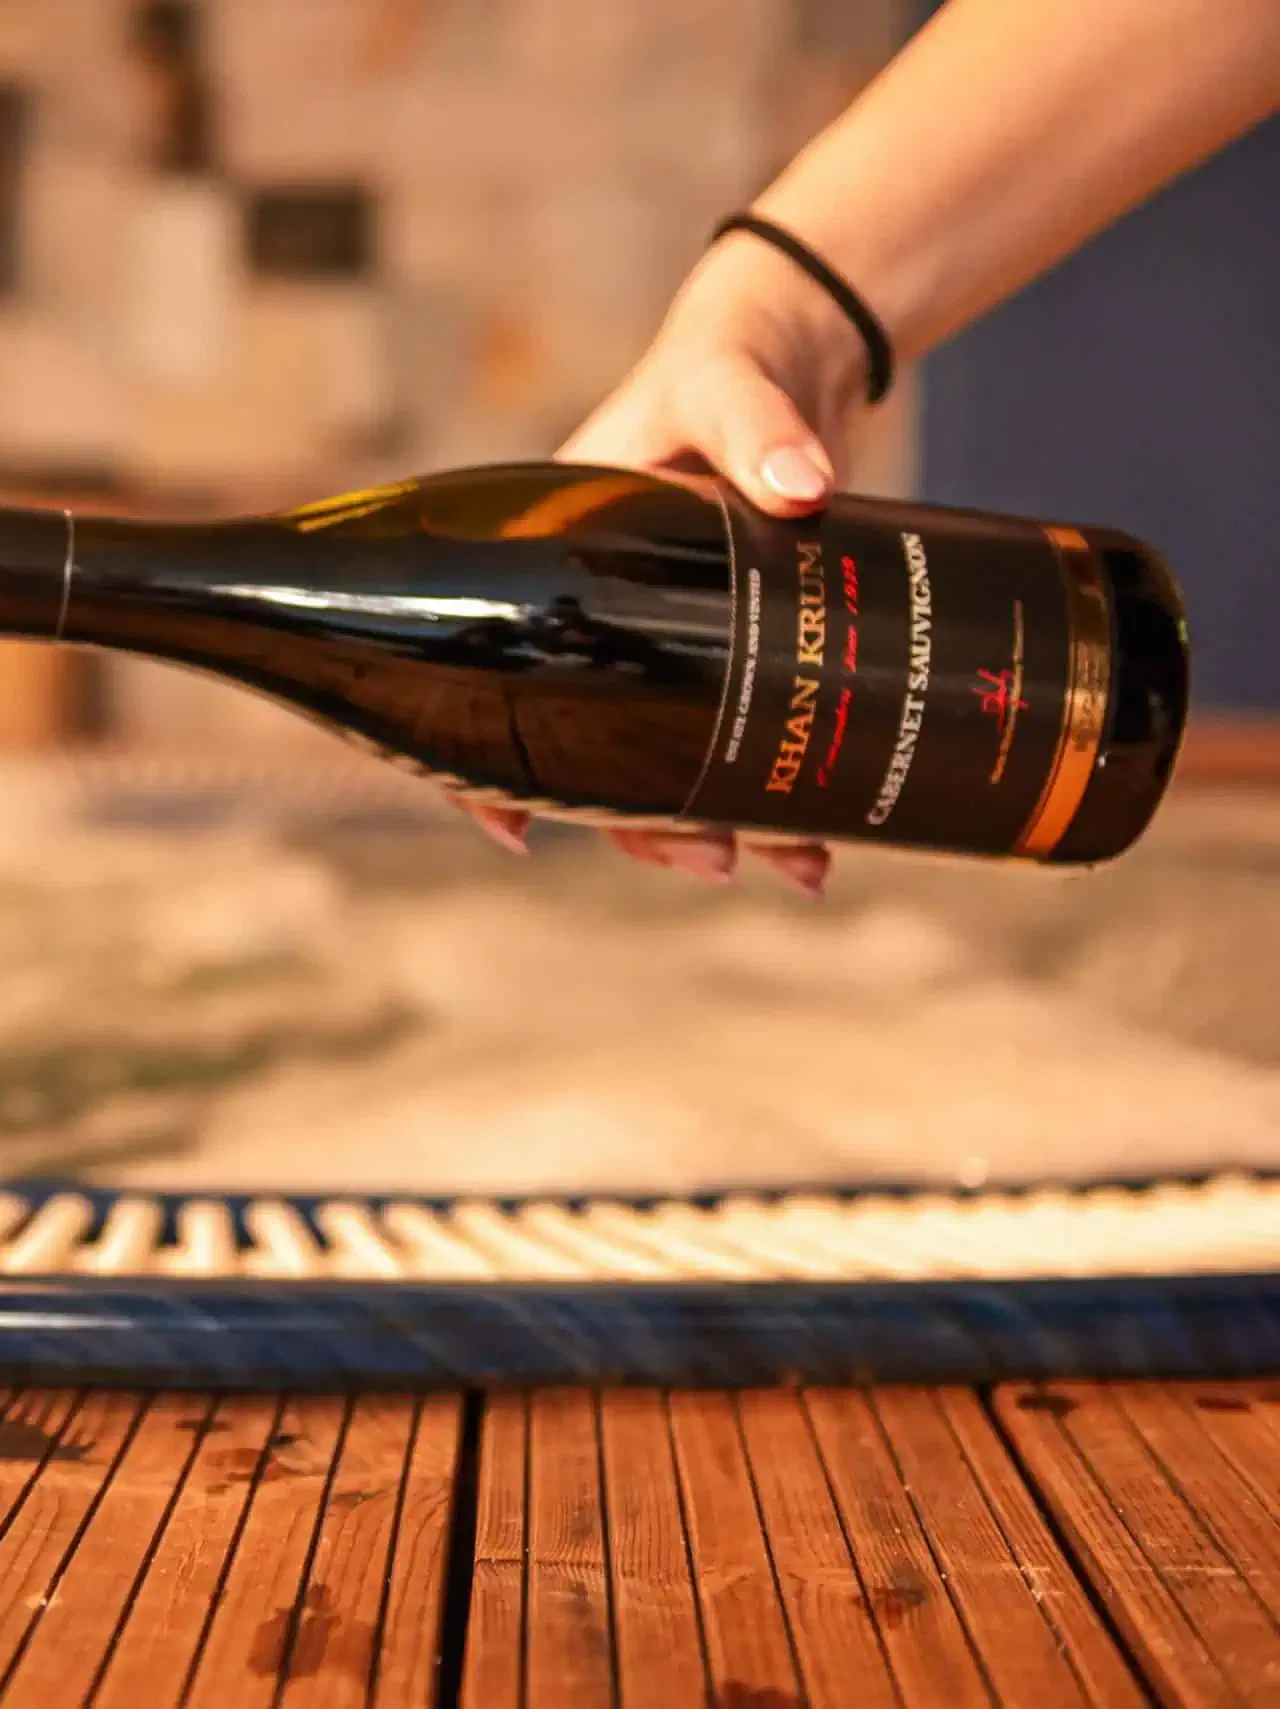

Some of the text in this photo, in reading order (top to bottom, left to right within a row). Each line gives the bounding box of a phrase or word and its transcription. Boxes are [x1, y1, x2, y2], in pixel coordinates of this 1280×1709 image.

[765, 540, 827, 794] KHAN KRUM
[866, 531, 932, 826] CABERNET SAUVIGNON
